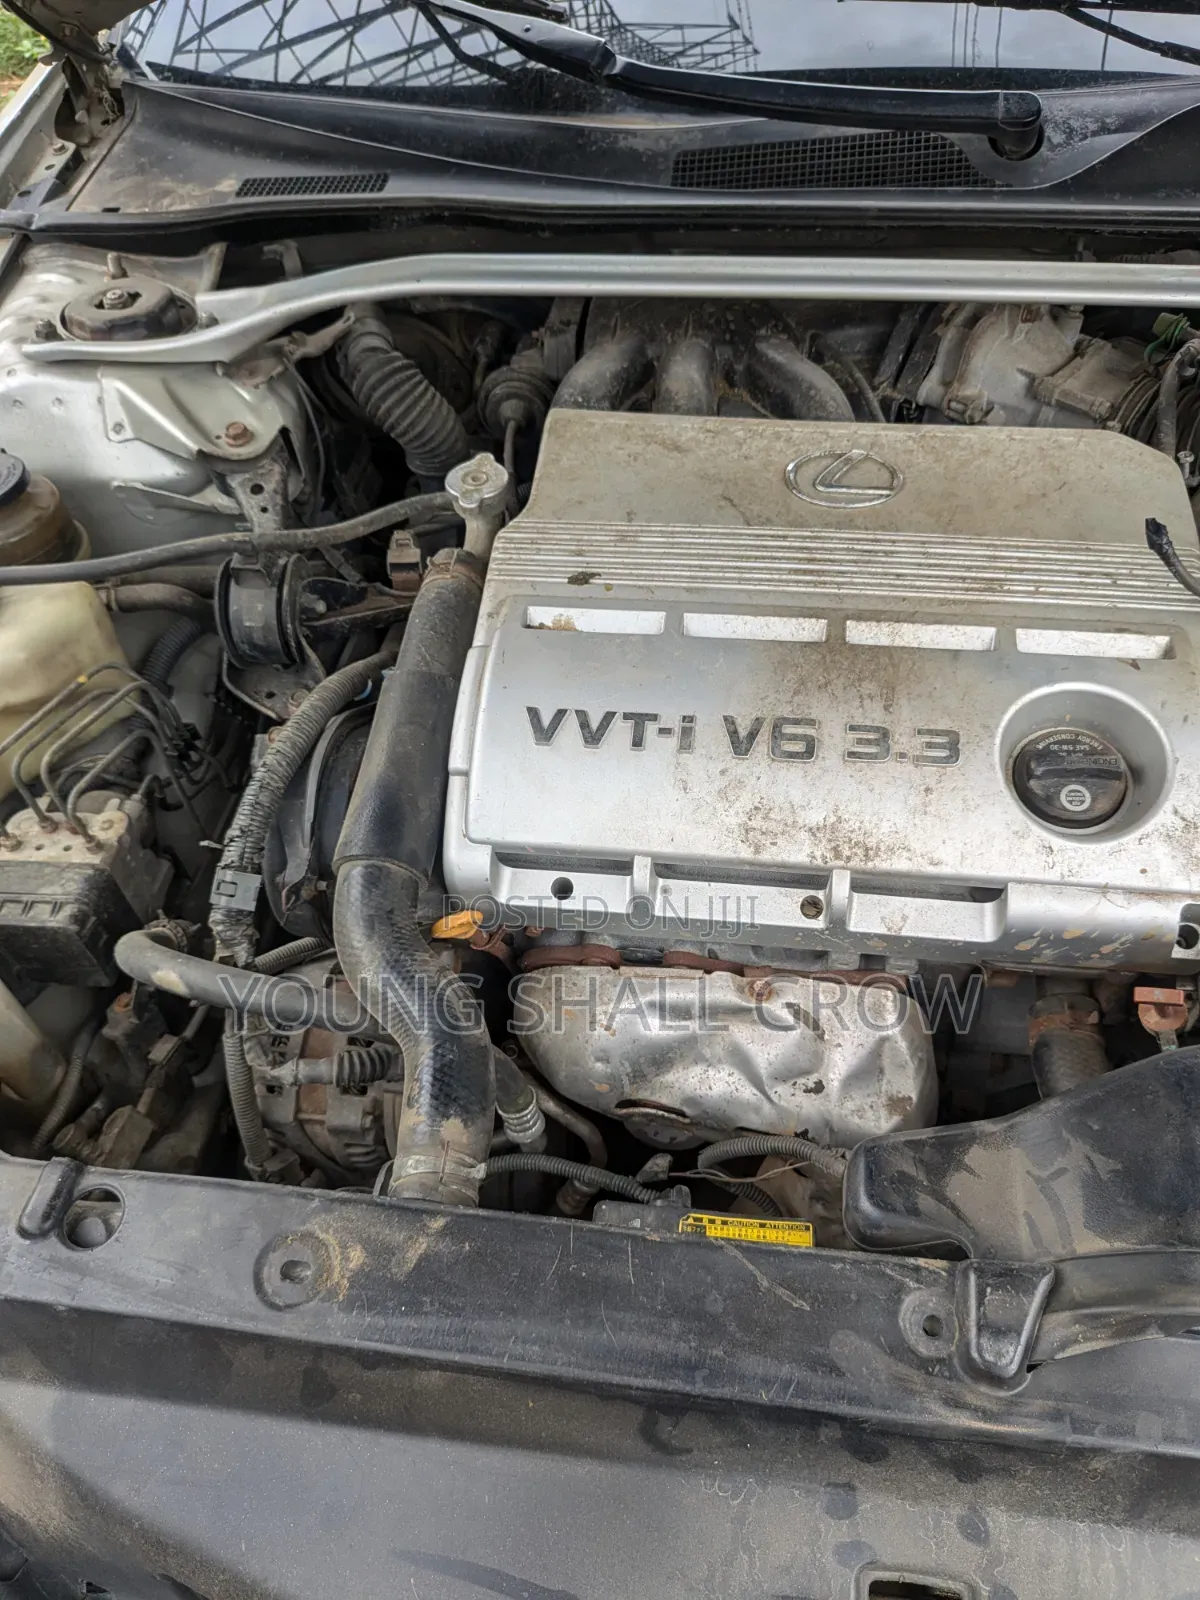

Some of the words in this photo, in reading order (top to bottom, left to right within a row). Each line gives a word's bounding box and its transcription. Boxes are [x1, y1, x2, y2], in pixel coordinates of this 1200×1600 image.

[525, 706, 697, 755] VVT-i
[722, 714, 821, 763] V6
[844, 723, 962, 767] 3.3
[1077, 735, 1103, 750] ENERGY
[727, 1219, 760, 1228] CAUTION
